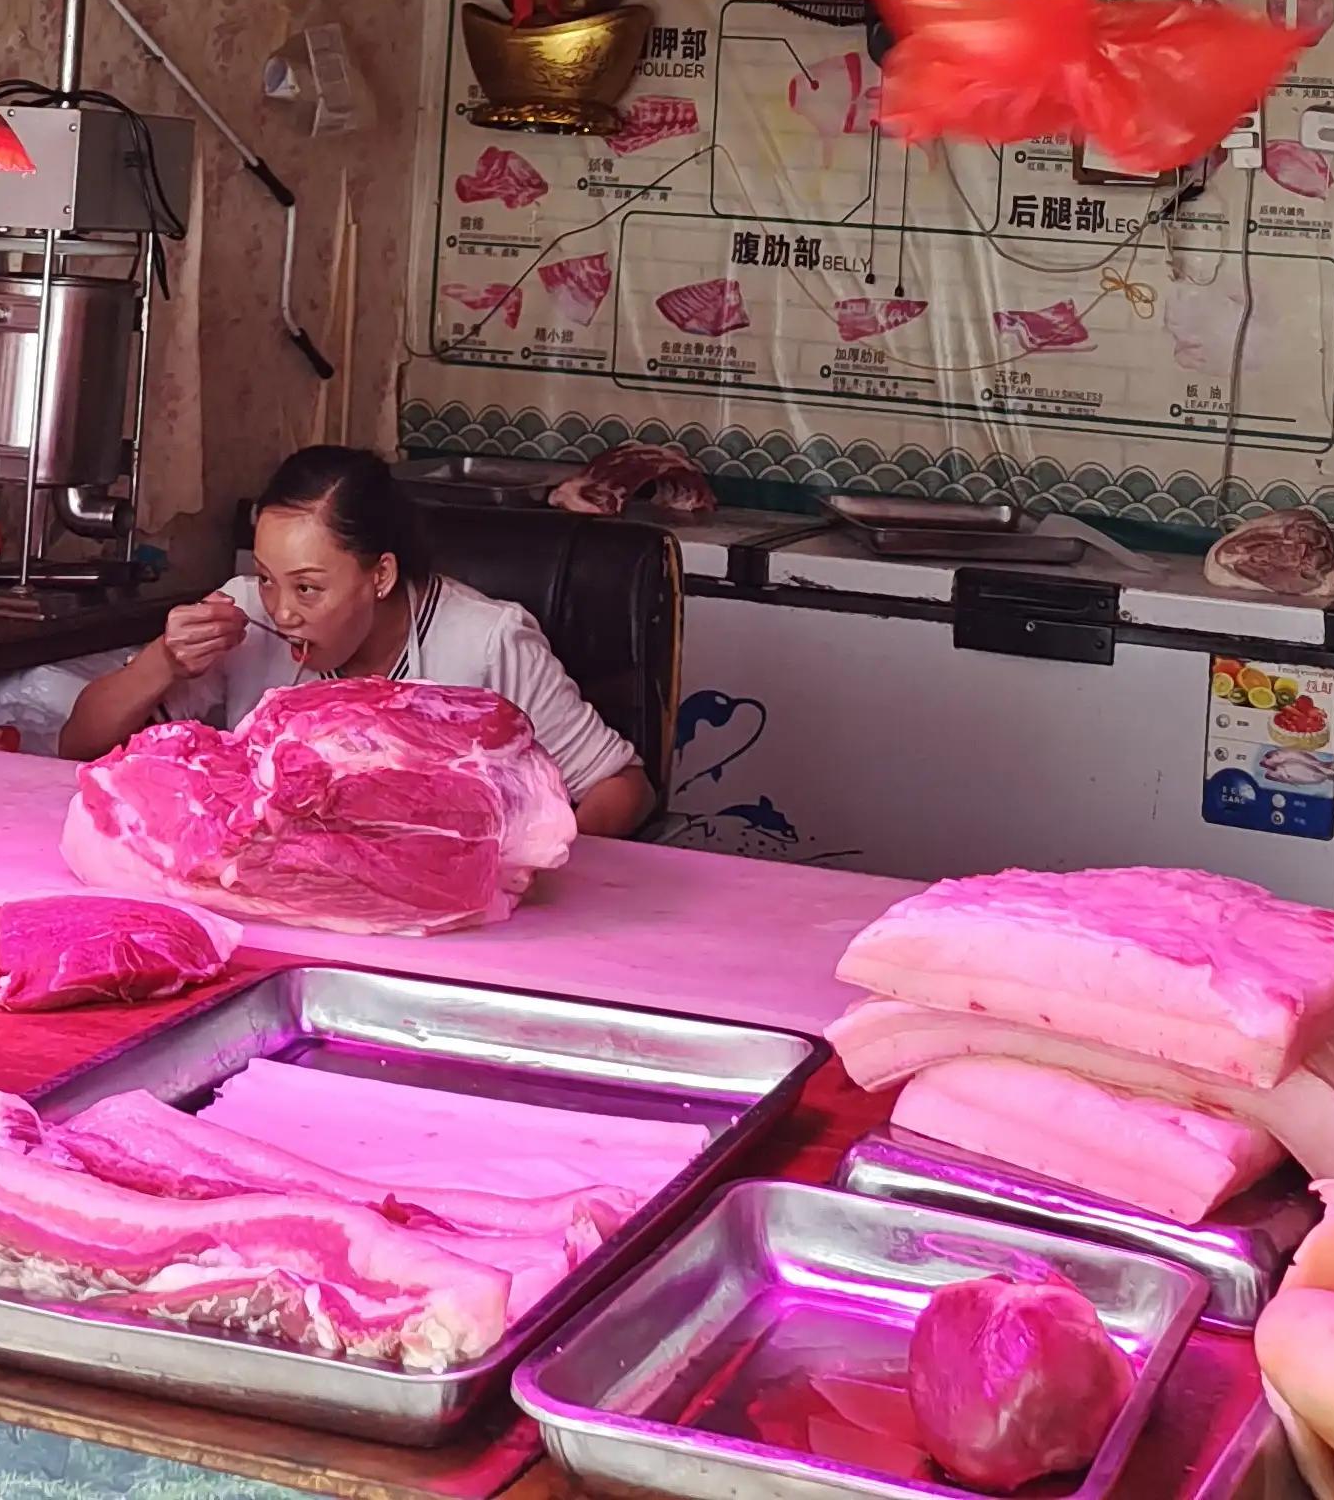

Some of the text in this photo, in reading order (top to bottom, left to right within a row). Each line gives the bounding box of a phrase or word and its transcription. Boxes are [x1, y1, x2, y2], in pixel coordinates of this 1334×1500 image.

[640, 27, 708, 61] 胛部
[634, 62, 706, 79] HOULDER
[1008, 194, 1107, 234] 后腿部
[1105, 216, 1141, 235] LEG
[731, 231, 872, 273] 腹肋部 BELLY
